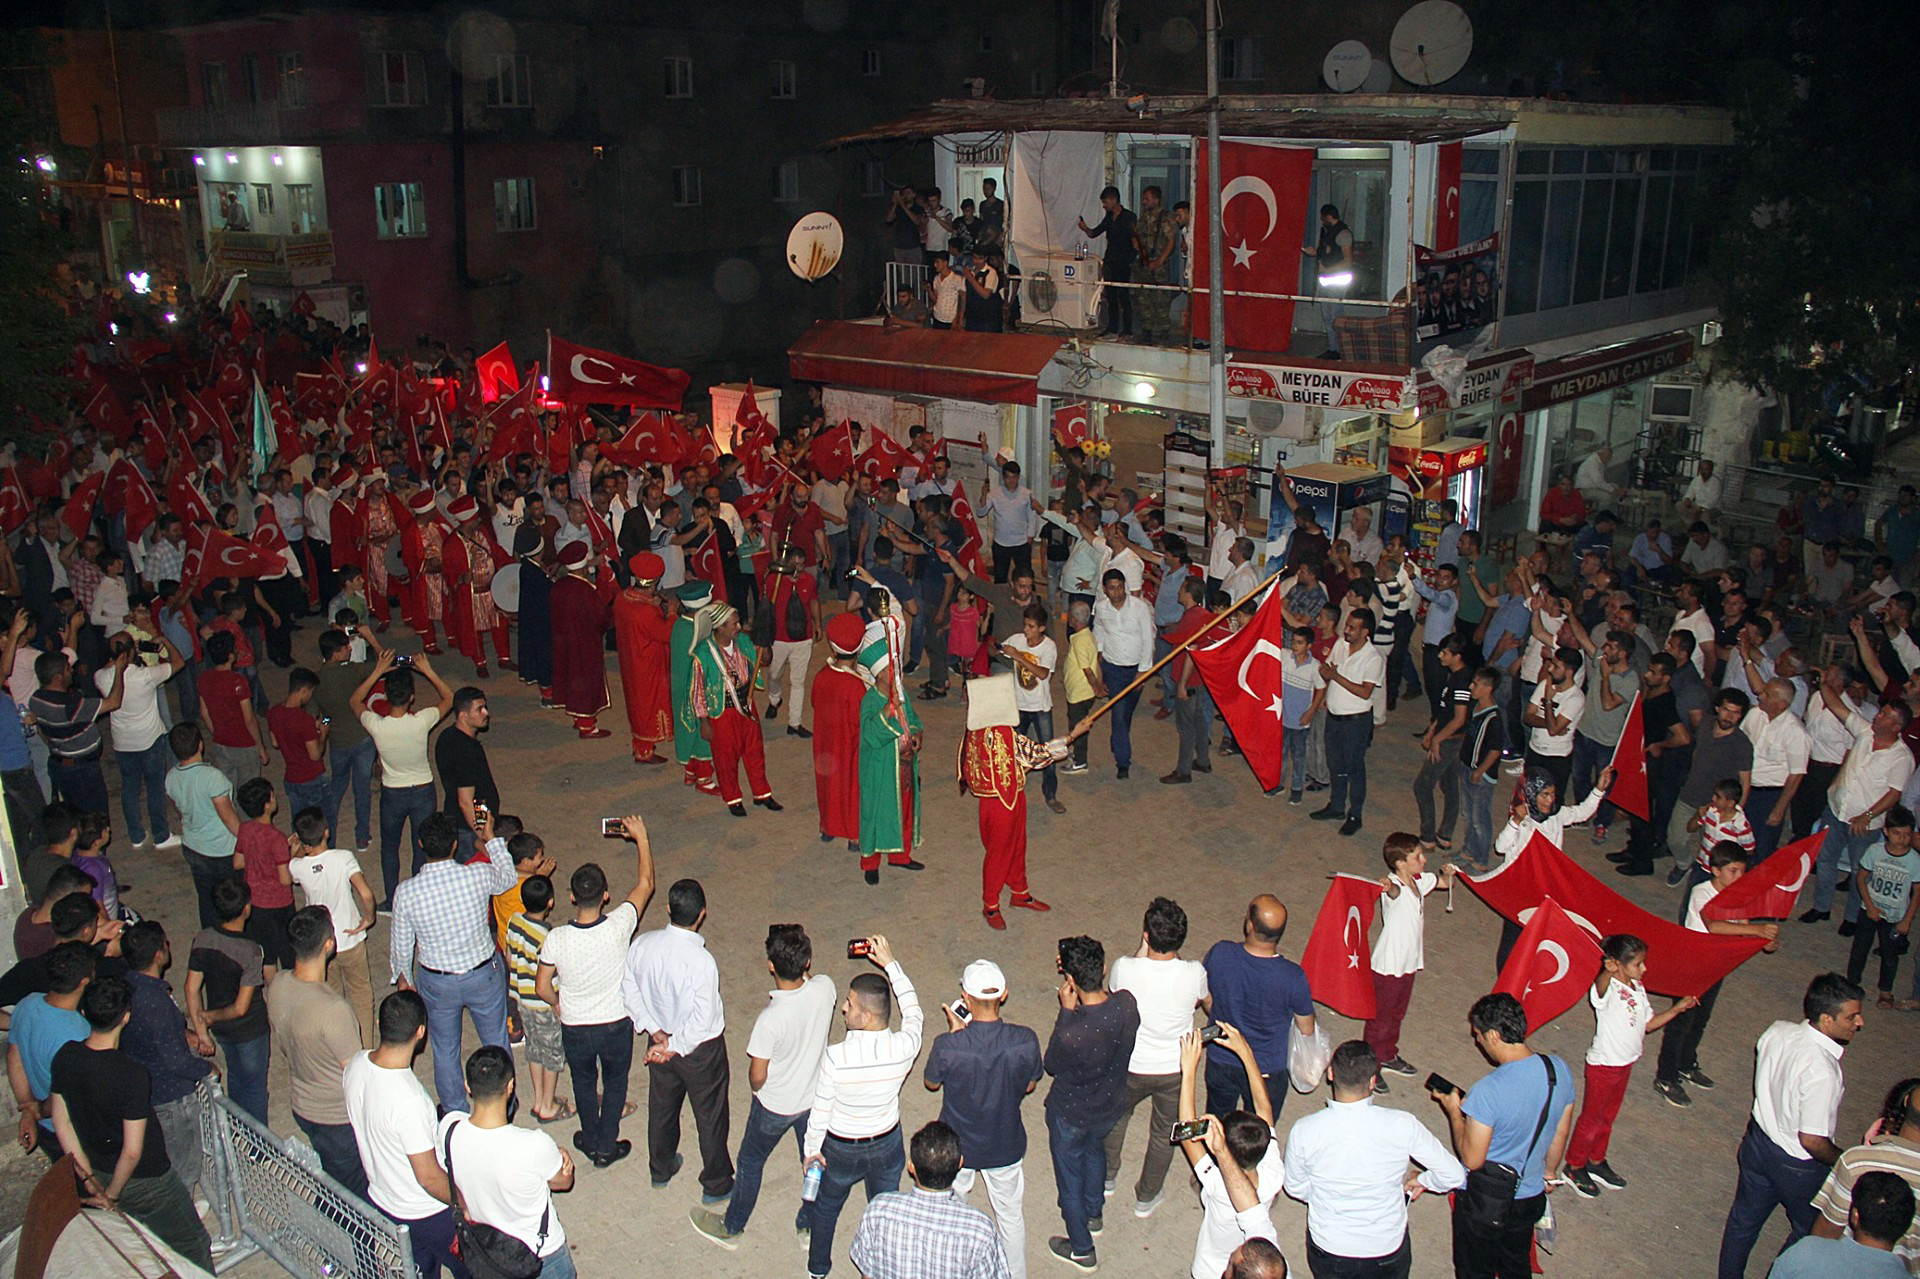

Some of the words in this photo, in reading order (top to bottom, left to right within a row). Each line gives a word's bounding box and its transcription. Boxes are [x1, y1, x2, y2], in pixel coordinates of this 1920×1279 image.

[1282, 371, 1342, 389] MEYDAN
[1463, 367, 1500, 389] EYDAN
[1550, 367, 1620, 399] MEYDAN
[1622, 359, 1651, 382] ÇAY
[1292, 389, 1330, 406] BÜFE
[1461, 387, 1491, 405] BÜFE
[1296, 484, 1328, 498] pepsi
